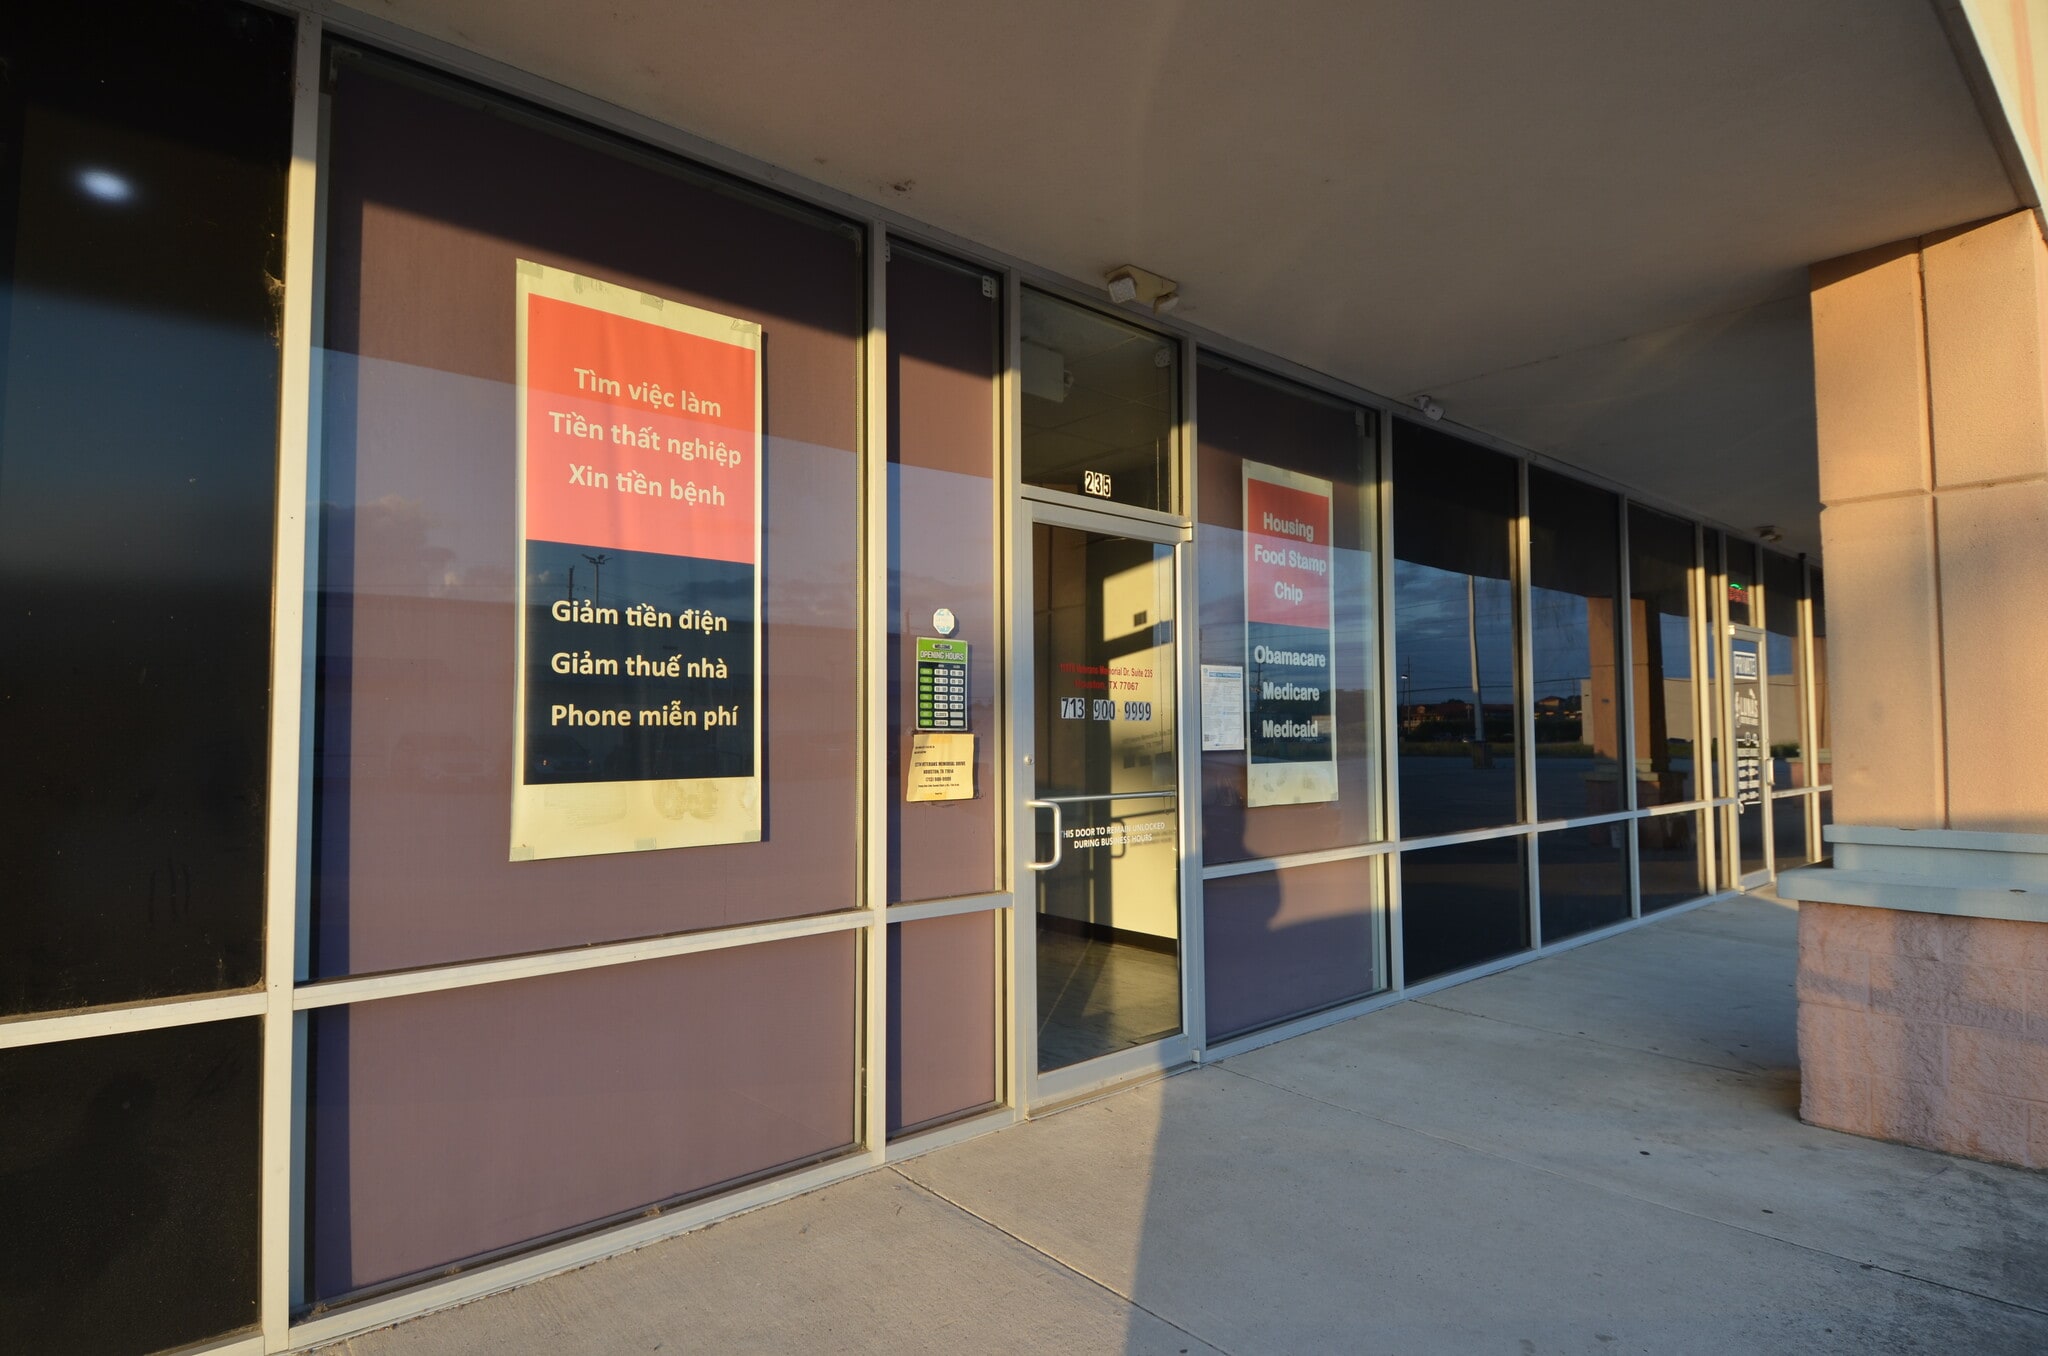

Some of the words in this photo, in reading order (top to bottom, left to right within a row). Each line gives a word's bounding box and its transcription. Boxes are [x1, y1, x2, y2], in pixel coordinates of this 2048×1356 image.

[574, 367, 620, 397] Tìm
[628, 379, 674, 409] việc
[681, 390, 721, 417] làm
[548, 411, 603, 440] Tiền
[611, 424, 660, 451] thất
[667, 436, 742, 468] nghiệp
[568, 463, 609, 489] Xin
[616, 470, 662, 497] tiền
[670, 479, 725, 506] bệnh
[1086, 472, 1110, 495] 235
[1263, 511, 1314, 542] Housing
[1254, 544, 1286, 567] Food
[1288, 549, 1327, 576] Stamp
[1274, 581, 1304, 606] Chip
[551, 599, 619, 625] Giảm
[625, 603, 671, 628] tiền
[678, 608, 728, 635] điện
[551, 650, 619, 676] Giảm
[625, 654, 682, 679] thuế
[687, 657, 728, 679] nhà
[920, 650, 945, 660] OPENING
[945, 651, 964, 661] HOURS
[1254, 645, 1326, 668] Obamacare
[1123, 667, 1131, 676] Dr.
[1131, 667, 1144, 677] Suite
[1144, 669, 1153, 678] 235
[1108, 681, 1118, 690] TX
[1120, 681, 1139, 691] 77067
[1262, 681, 1320, 701] Medicare
[551, 704, 632, 727] Phone
[639, 700, 697, 727] miễn
[704, 705, 740, 731] phí
[1062, 698, 1084, 718] 713
[1094, 700, 1115, 720] 900
[1124, 702, 1152, 721] 9999
[1262, 719, 1319, 738] Medicaid
[1074, 838, 1100, 849] DURING
[1101, 836, 1130, 846] BUSINESS
[1132, 833, 1153, 843] HOURS
[1075, 827, 1095, 838] DOOR
[1096, 826, 1106, 835] TO
[1106, 824, 1131, 834] REMAIN
[1132, 822, 1165, 832] UNLOCKED
